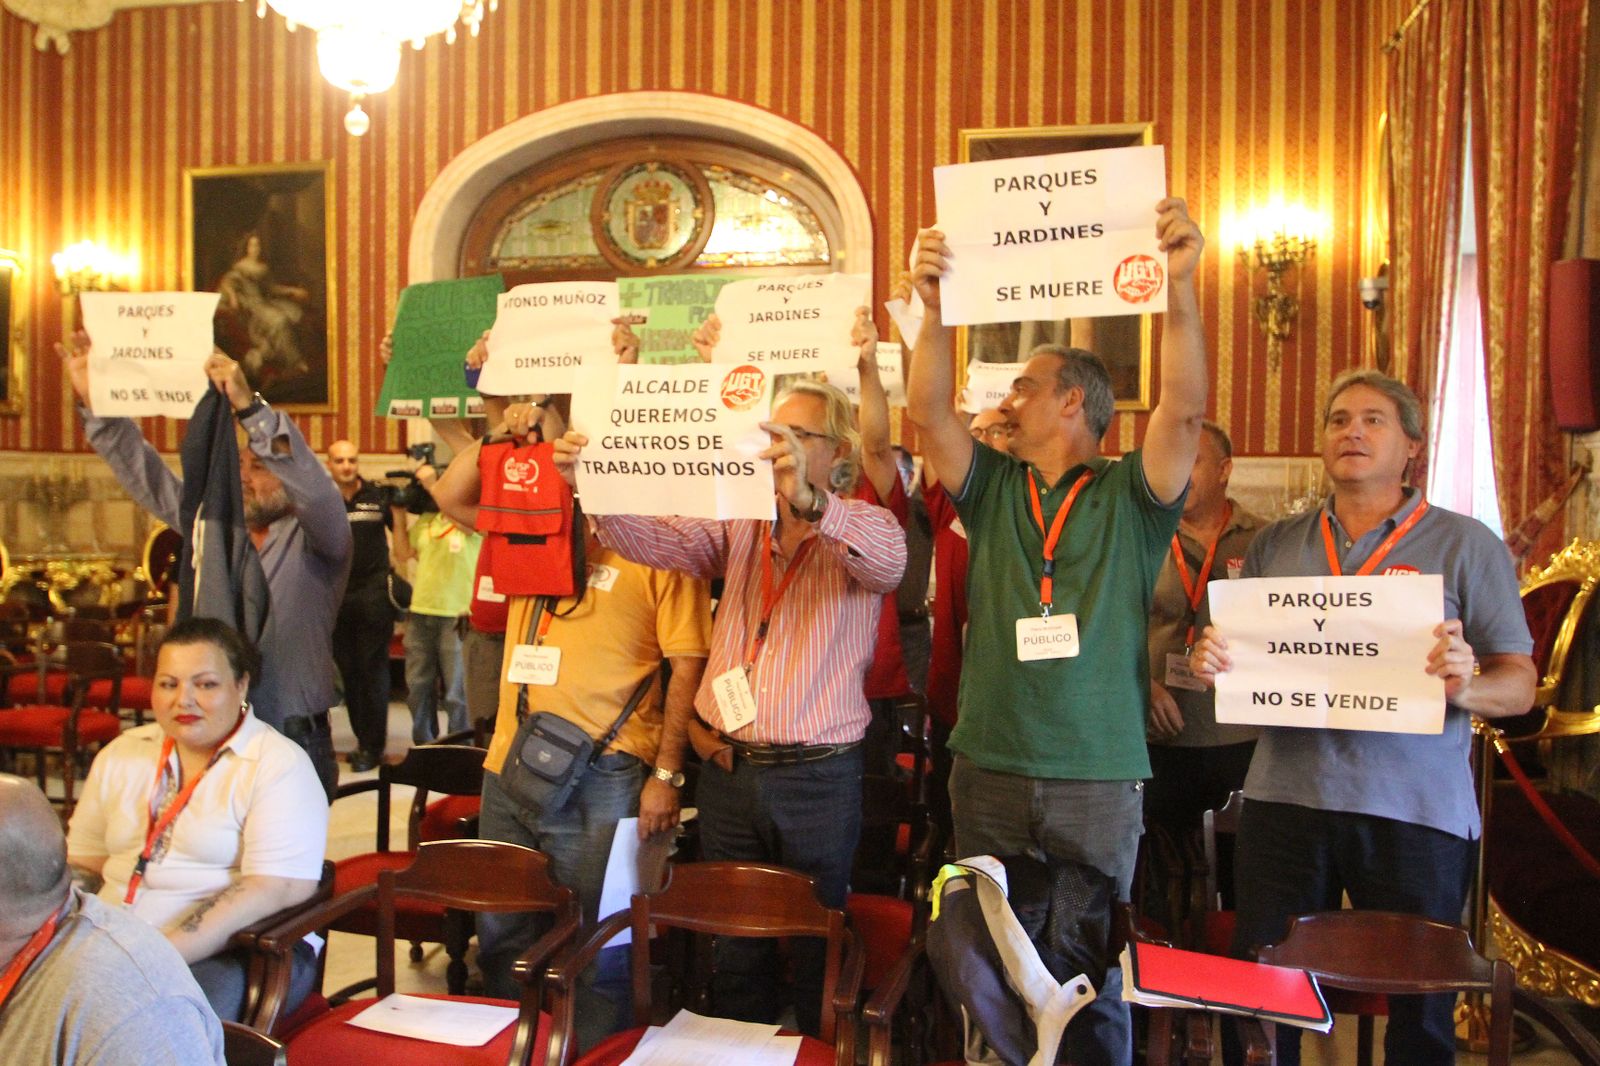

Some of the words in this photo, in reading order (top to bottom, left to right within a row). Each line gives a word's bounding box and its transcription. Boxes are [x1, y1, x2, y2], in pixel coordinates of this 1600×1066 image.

[994, 168, 1098, 194] PARQUES
[1038, 201, 1051, 216] Y
[992, 223, 1105, 247] JARDINES
[757, 279, 824, 294] PARQUES
[996, 286, 1022, 302] SE
[1030, 279, 1103, 299] MUERE
[553, 290, 606, 306] MUÑOZ
[118, 305, 175, 320] PARQUES
[749, 308, 820, 324] JARDINES
[142, 327, 149, 339] Y
[111, 347, 174, 360] JARDINES
[515, 353, 583, 369] DIMISIÓN
[747, 350, 765, 362] SE
[770, 347, 820, 361] MUERE
[110, 389, 128, 401] NO
[132, 388, 149, 401] SE
[622, 379, 710, 395] ALCALDE
[610, 407, 717, 427] QUEREMOS
[601, 435, 690, 451] CENTROS
[697, 435, 724, 450] DE
[582, 460, 666, 476] TRABAJO
[673, 461, 756, 477] DIGNOS
[1268, 592, 1373, 611] PARQUES
[1312, 618, 1326, 632] Y
[1267, 642, 1379, 657] JARDINES
[1252, 691, 1283, 706] NO
[1290, 692, 1316, 707] SE
[1324, 693, 1398, 712] VENDE
